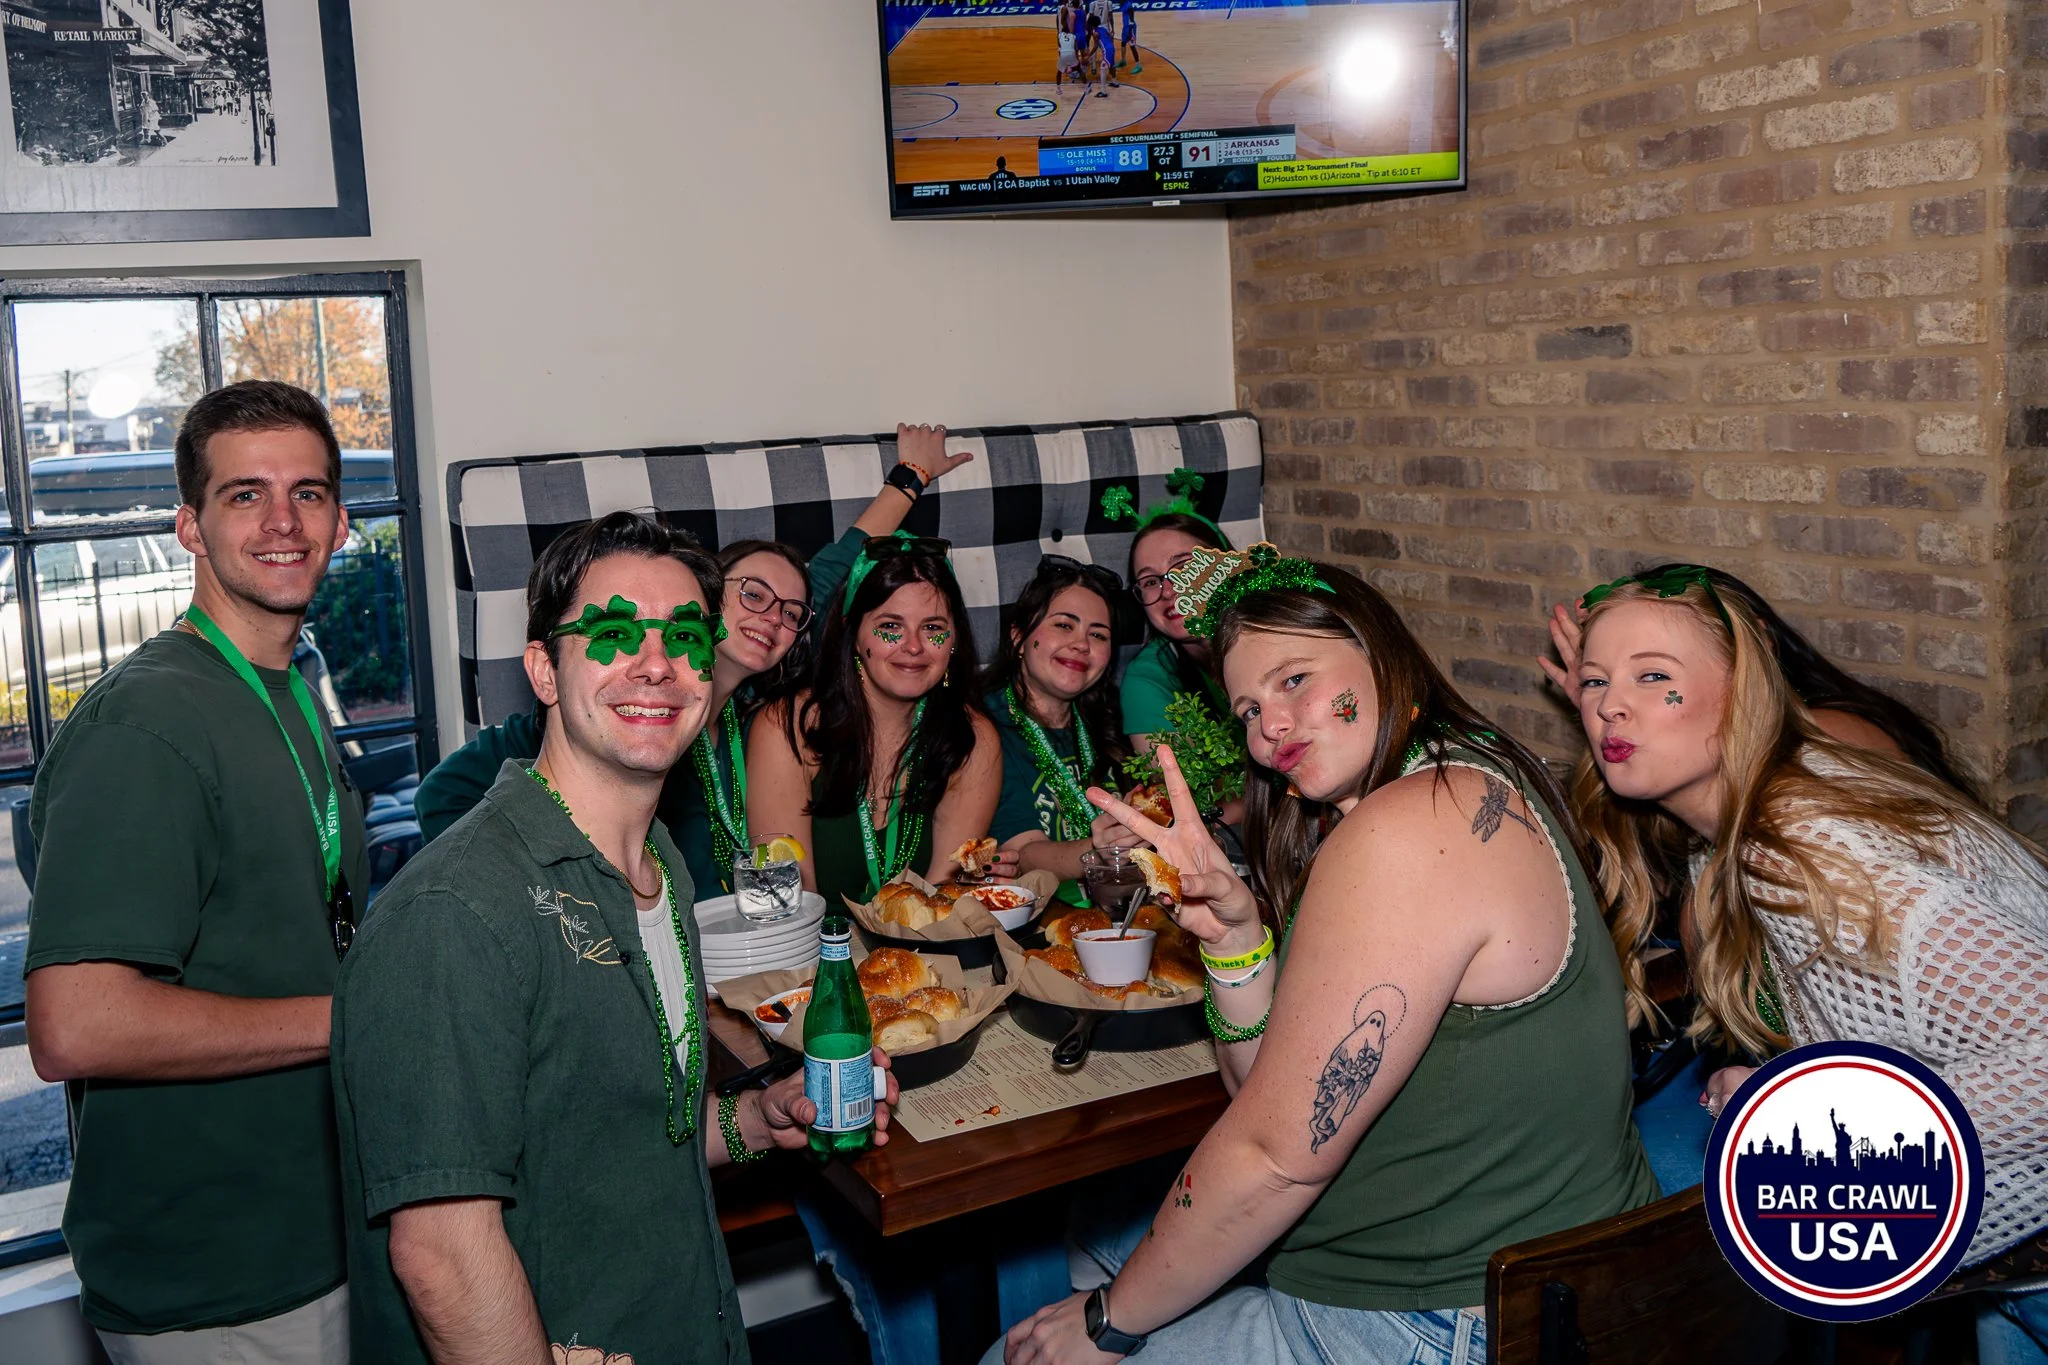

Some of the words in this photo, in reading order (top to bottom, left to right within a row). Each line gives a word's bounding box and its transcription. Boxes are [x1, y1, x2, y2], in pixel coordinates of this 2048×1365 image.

[977, 5, 1035, 14] JUST
[54, 31, 90, 41] RETAIL
[93, 30, 138, 41] MARKET
[1125, 133, 1173, 142] TOURNAMENT
[1180, 131, 1218, 139] SEMIFINAL
[1230, 139, 1280, 148] ARKANSAS
[1066, 150, 1084, 158] OLE
[1086, 149, 1107, 157] MISS
[1153, 146, 1175, 156] 27.3
[1188, 146, 1211, 162] 91
[1118, 149, 1143, 166] 88
[1158, 157, 1171, 165] OT
[1263, 165, 1282, 173] Next:
[1283, 164, 1296, 173] Big
[1306, 162, 1349, 171] Tournament
[1367, 169, 1380, 179] Tip
[1381, 169, 1390, 177] at
[1391, 168, 1408, 176] 6:10
[1410, 167, 1421, 175] ET
[960, 182, 978, 191] WAC
[978, 181, 992, 191] (M)
[1004, 180, 1017, 189] CA
[1019, 177, 1050, 189] Baptist
[1071, 175, 1093, 185] Utah
[1094, 174, 1120, 186] Valley
[1163, 182, 1190, 190] ESPN2
[913, 184, 950, 197] ESPN
[1168, 551, 1215, 593] Irish
[1175, 556, 1241, 616] Princess
[1035, 728, 1055, 755] CRAWL
[1068, 778, 1081, 796] BAR
[1077, 793, 1096, 819] CRAWL
[327, 812, 338, 836] USA
[860, 808, 873, 840] CRAWL
[319, 825, 330, 851] BAR
[867, 840, 875, 860] BAR
[1221, 960, 1246, 968] lucky
